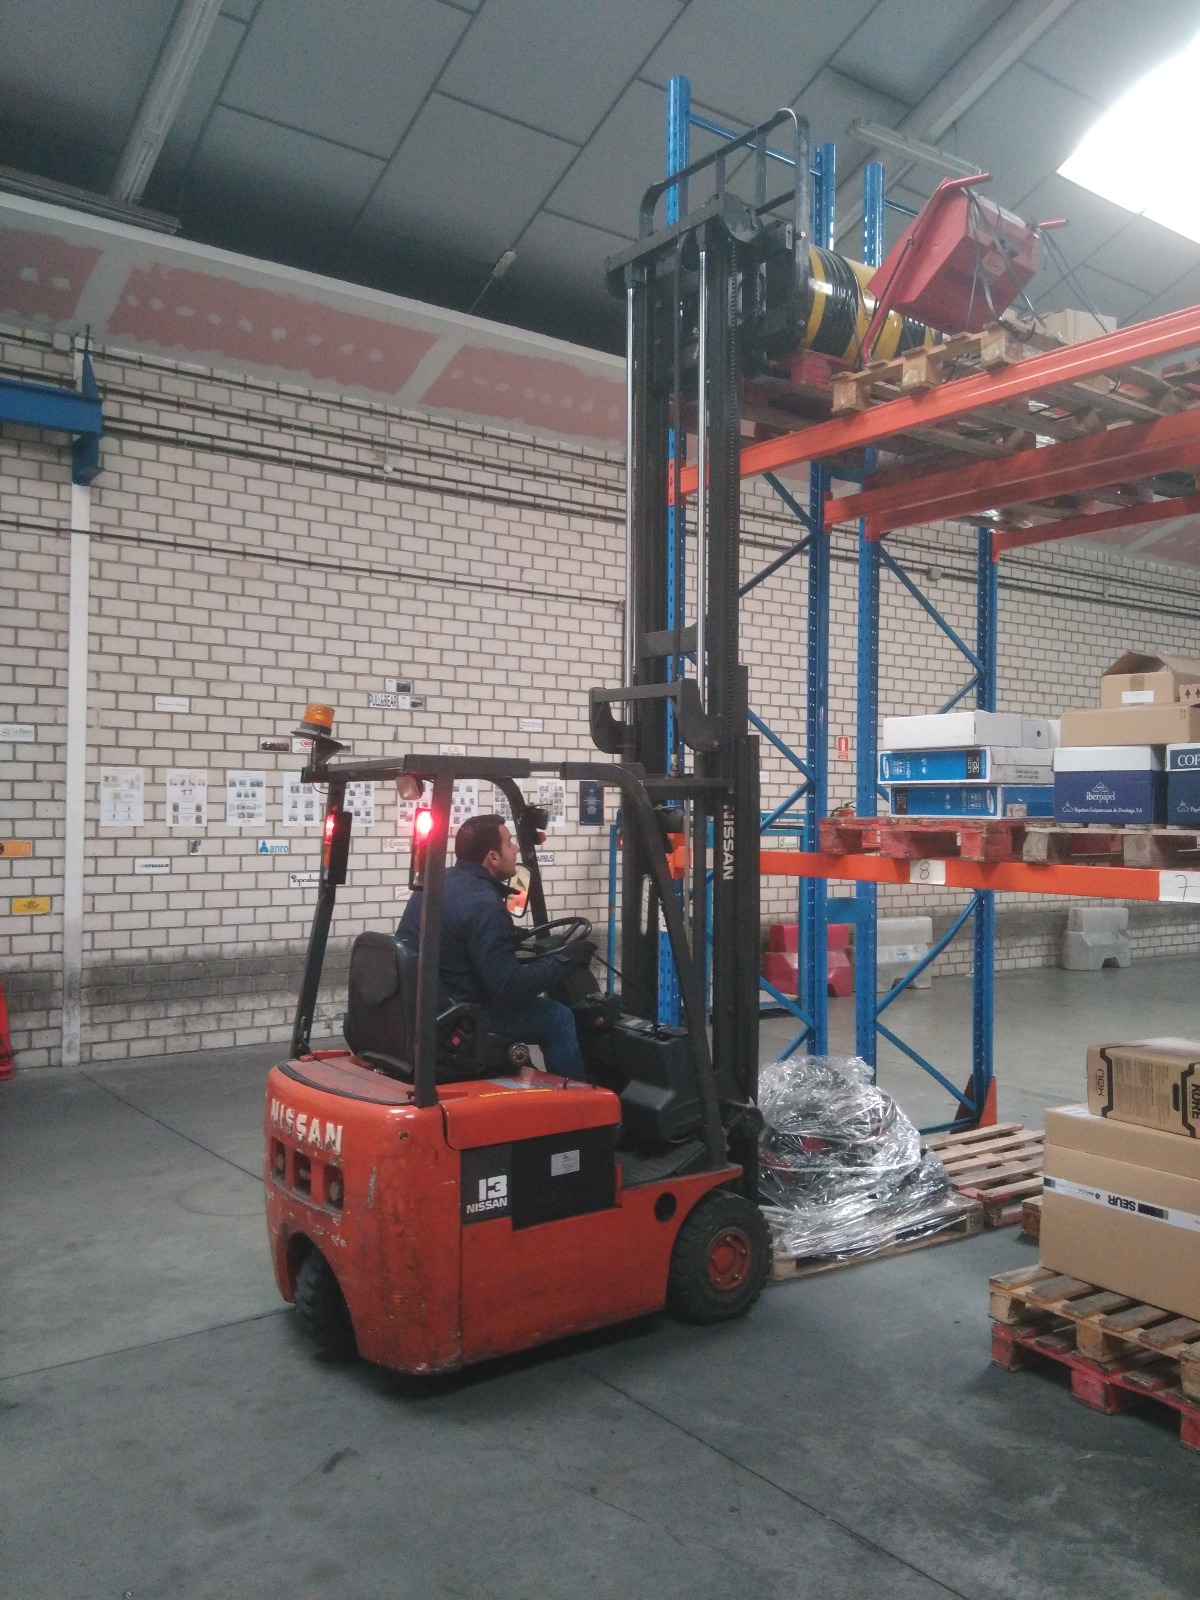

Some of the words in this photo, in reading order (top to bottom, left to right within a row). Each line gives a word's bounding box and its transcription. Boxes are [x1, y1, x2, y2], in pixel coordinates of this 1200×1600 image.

[1086, 790, 1116, 804] iberpapel
[269, 844, 289, 853] anro
[723, 804, 735, 880] NISSAN
[919, 862, 931, 881] 8
[1174, 874, 1192, 901] 7
[270, 1098, 343, 1155] NISSAN
[478, 1174, 508, 1200] 13
[466, 1197, 508, 1214] NISSAN
[1108, 1193, 1136, 1211] SEUR
